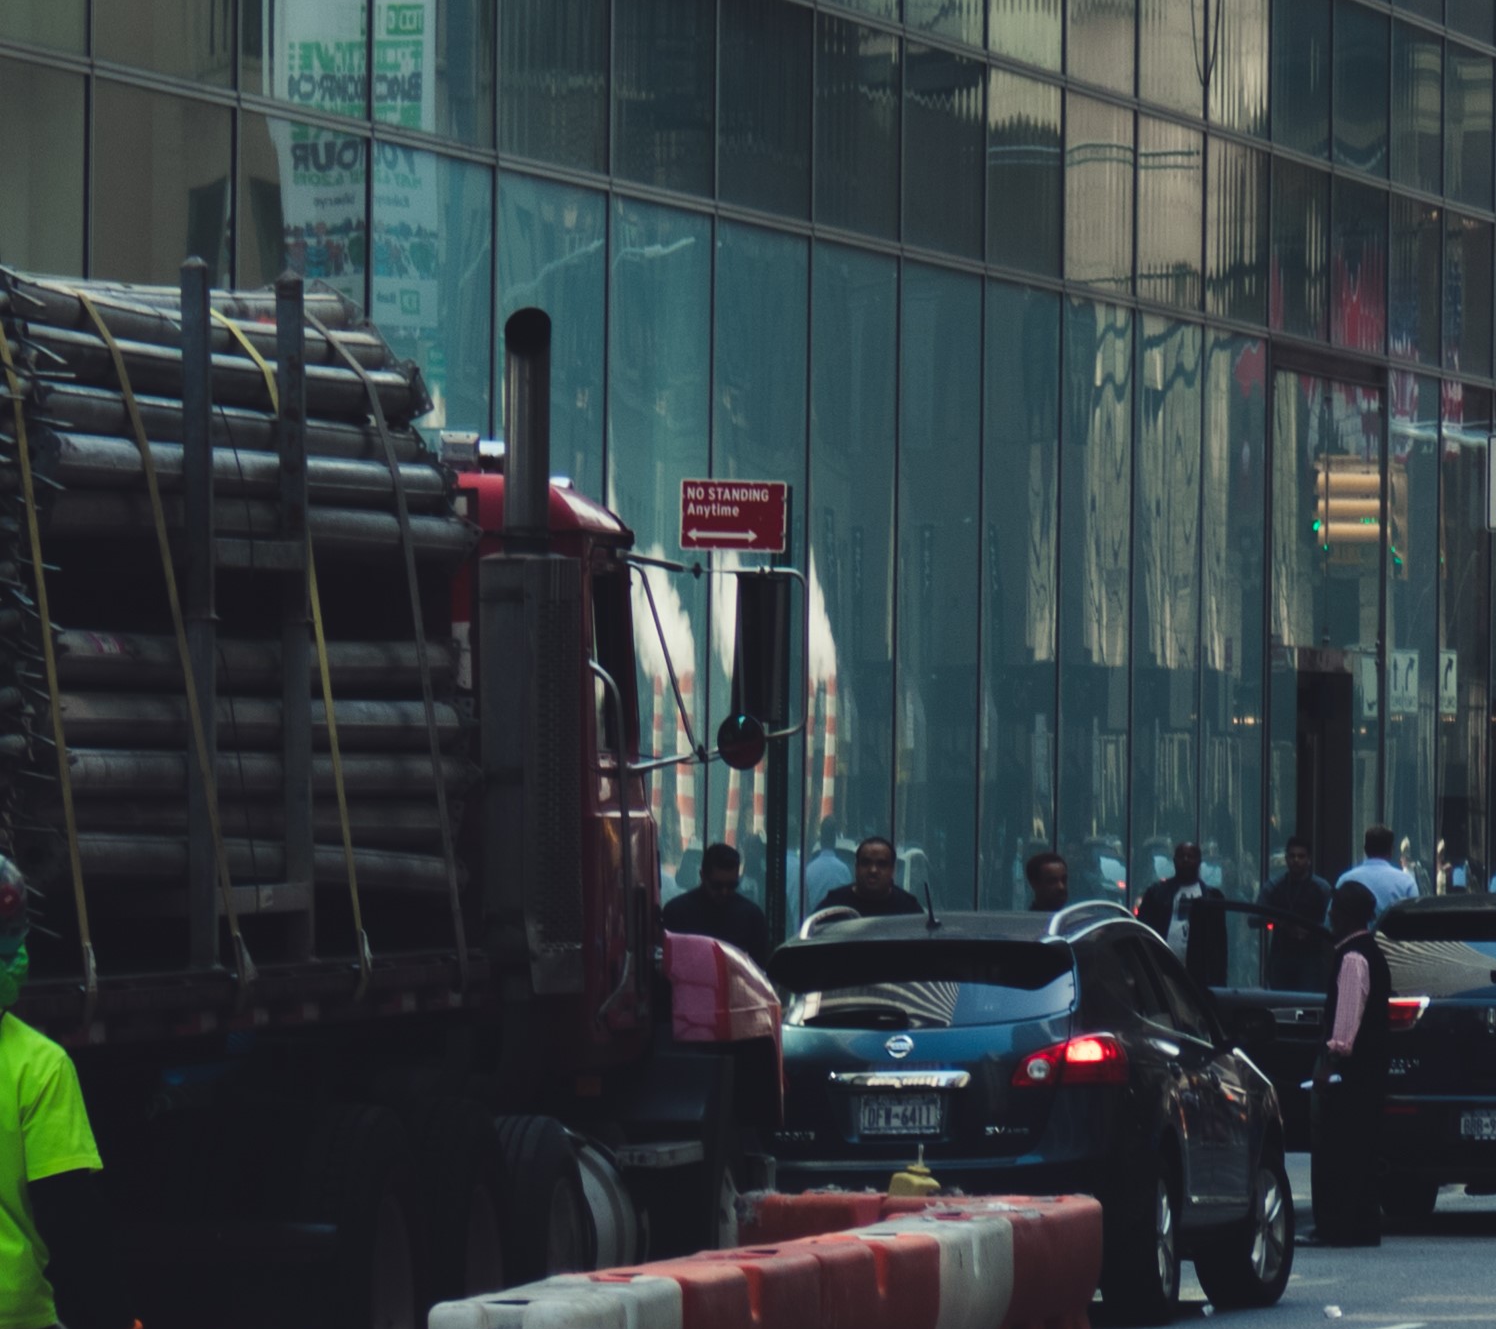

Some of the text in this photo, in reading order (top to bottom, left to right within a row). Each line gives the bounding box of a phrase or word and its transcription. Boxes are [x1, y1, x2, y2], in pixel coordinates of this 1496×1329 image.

[686, 486, 770, 502] NO STANDING
[687, 503, 740, 518] Anytime
